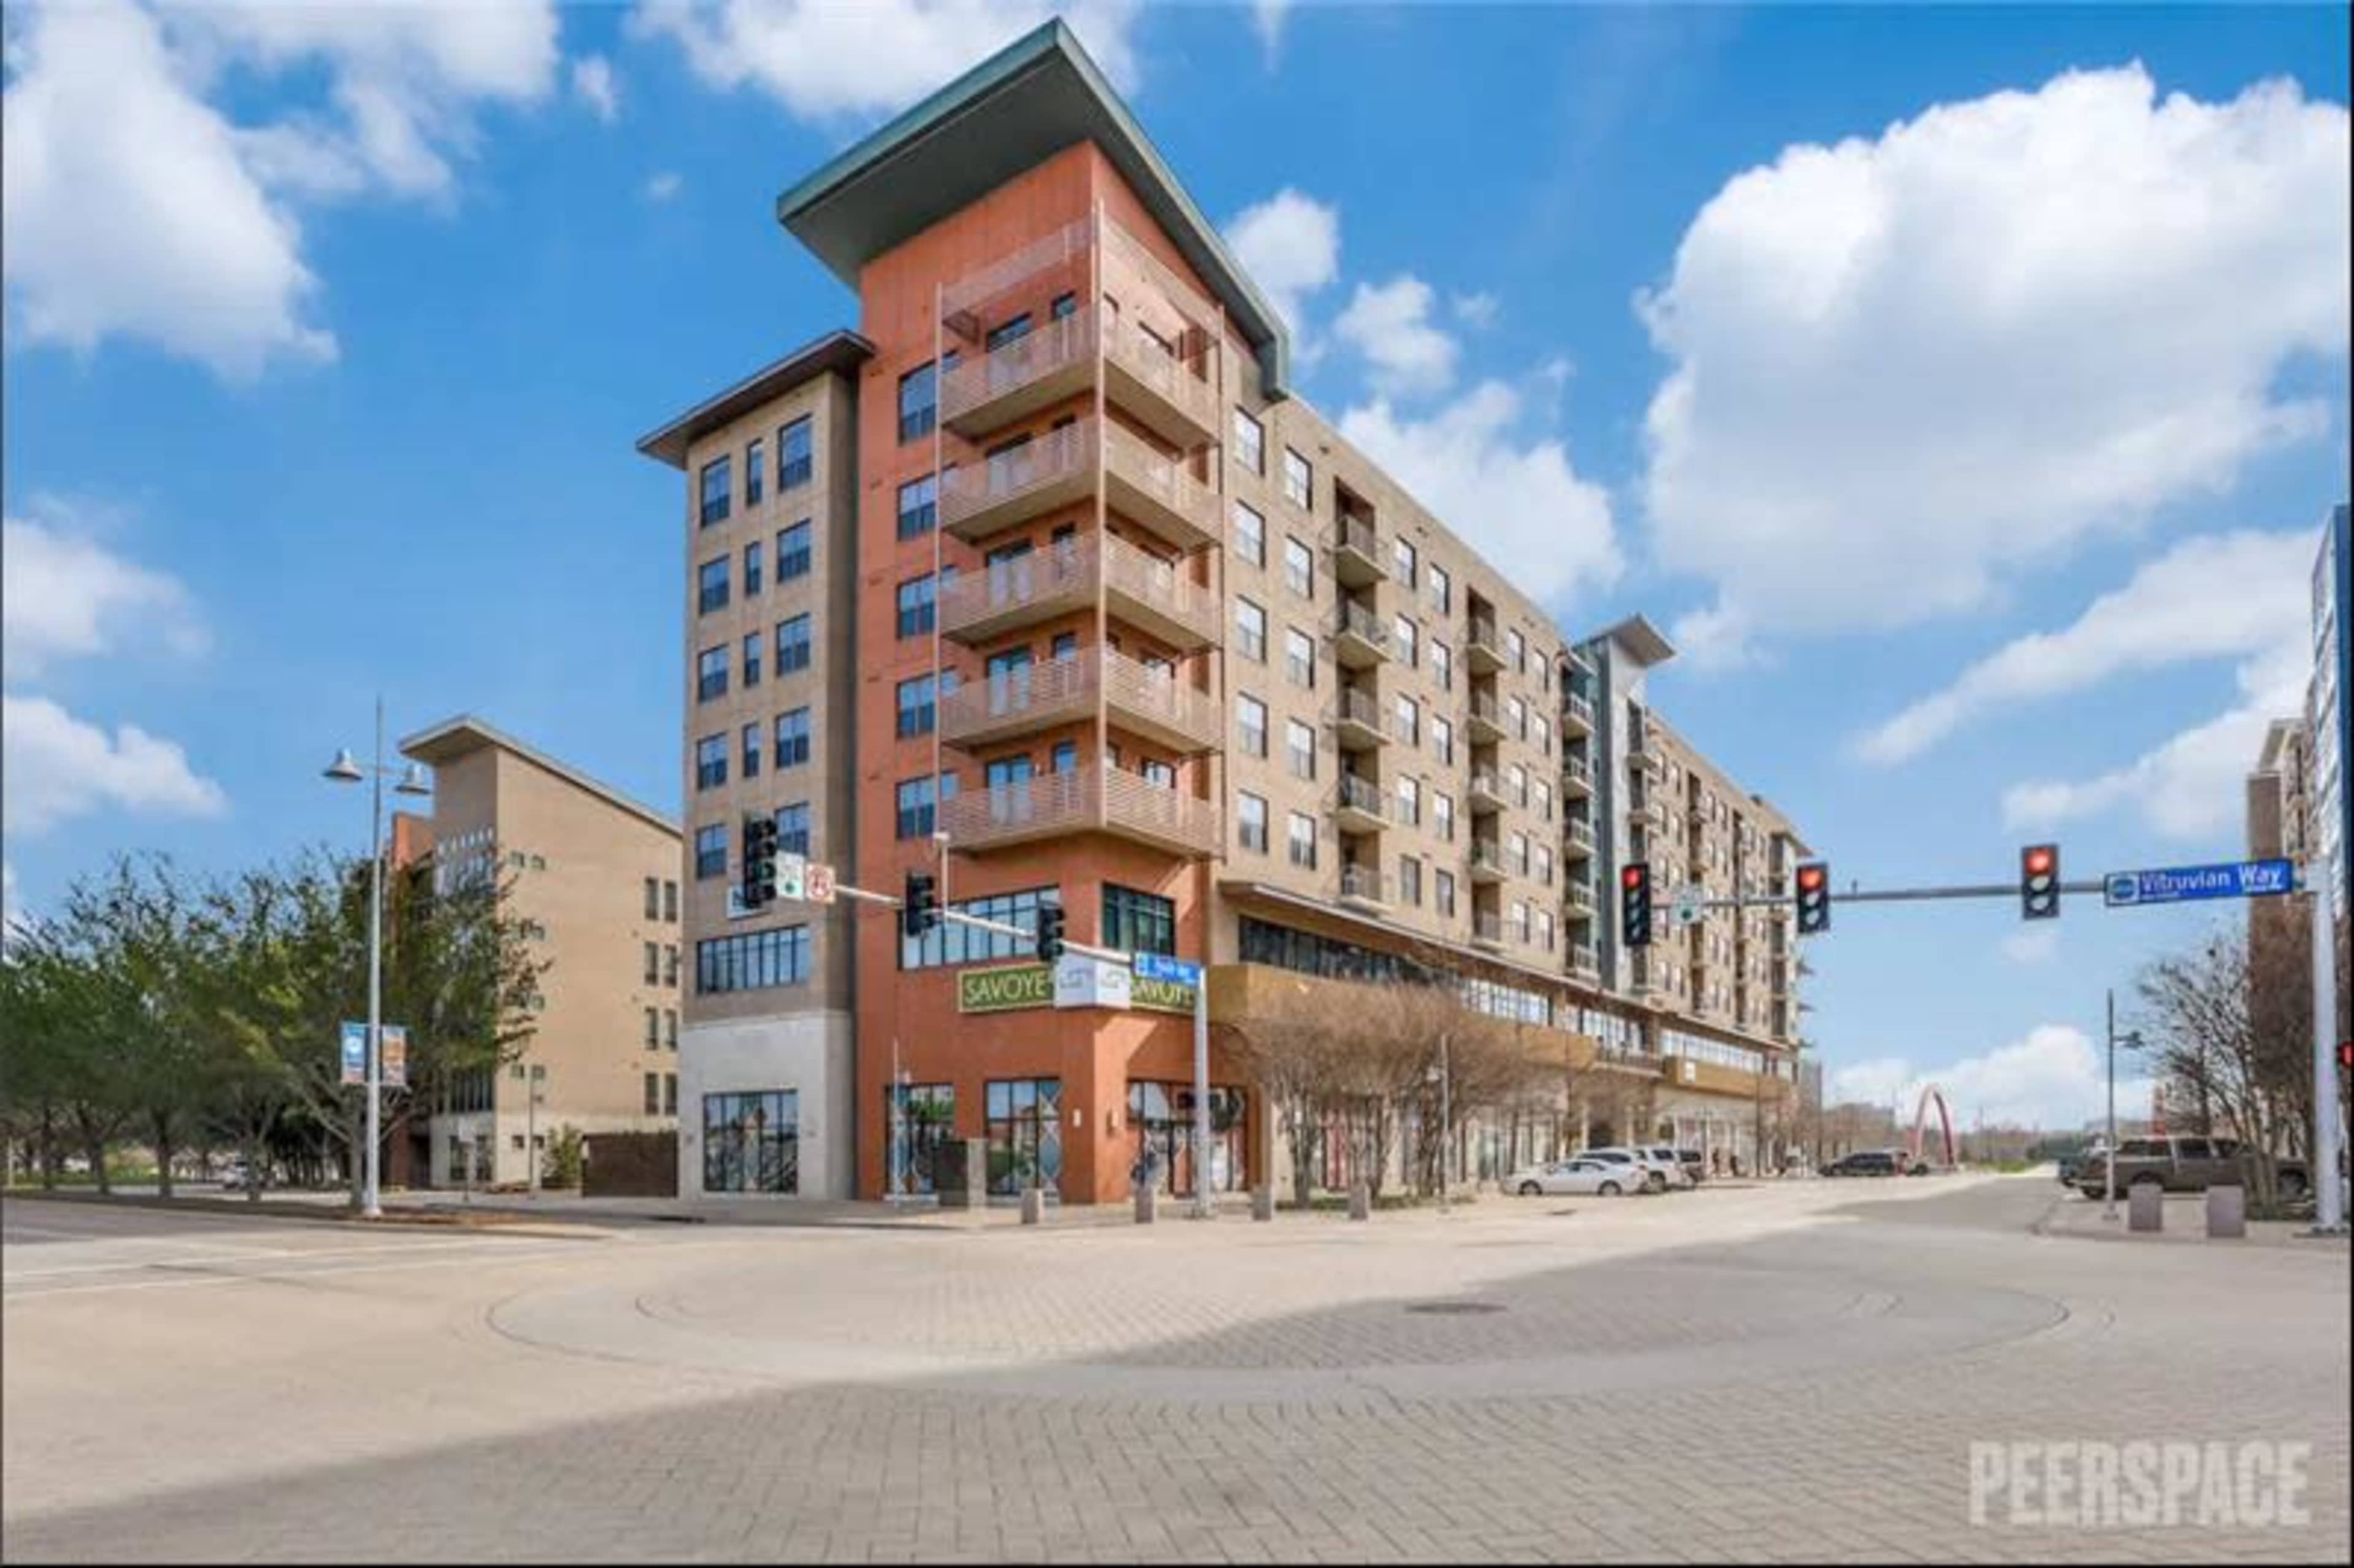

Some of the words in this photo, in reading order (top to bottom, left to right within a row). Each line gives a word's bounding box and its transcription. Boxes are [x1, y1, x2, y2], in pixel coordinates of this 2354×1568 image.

[2142, 870, 2231, 892] Vitruvian
[2238, 864, 2283, 889] Way
[965, 970, 1046, 1004] SAVOYE
